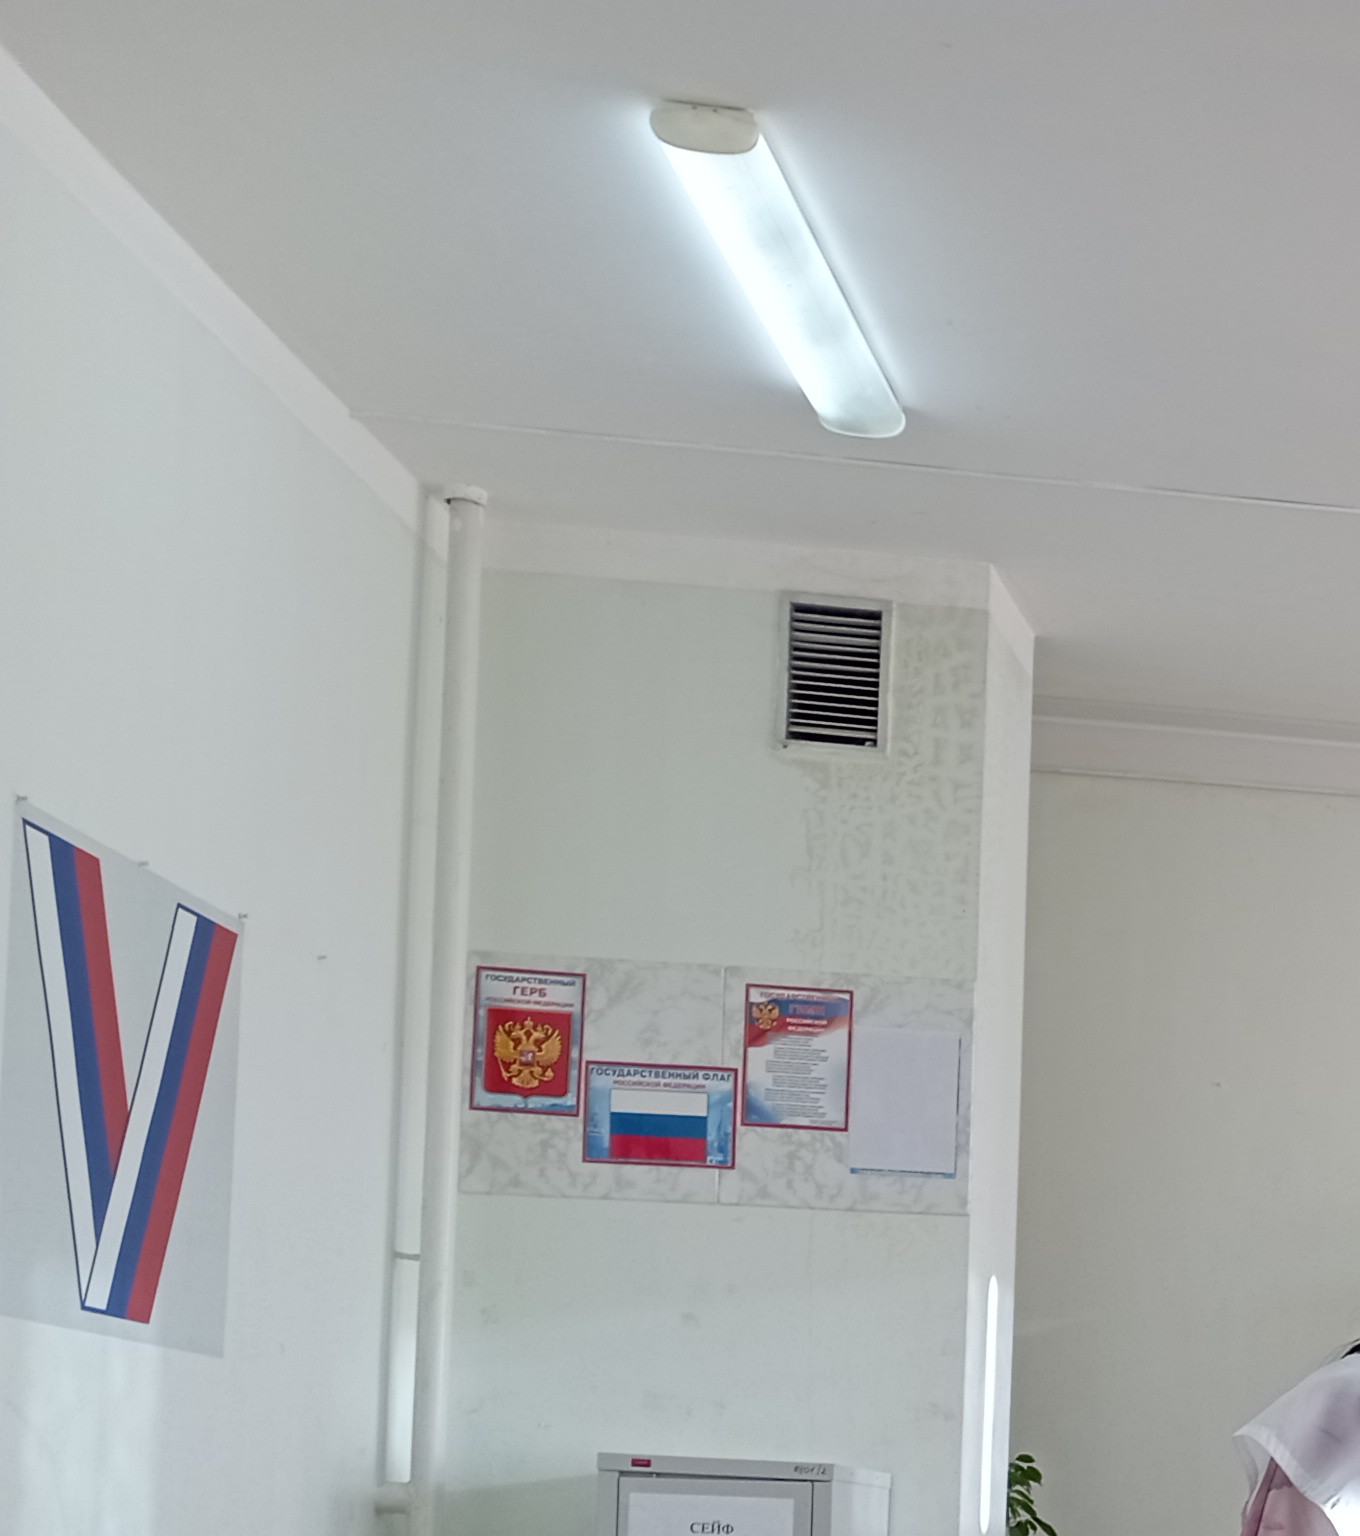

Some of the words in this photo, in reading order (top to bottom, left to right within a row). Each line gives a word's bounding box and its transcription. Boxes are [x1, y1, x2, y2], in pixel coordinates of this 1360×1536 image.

[513, 986, 547, 998] ГЕРБ
[590, 1067, 699, 1080] ГОСУДАРСТВЕННЫЙ
[702, 1073, 732, 1081] ФЛАГ
[690, 1520, 734, 1535] СЕЙФ
